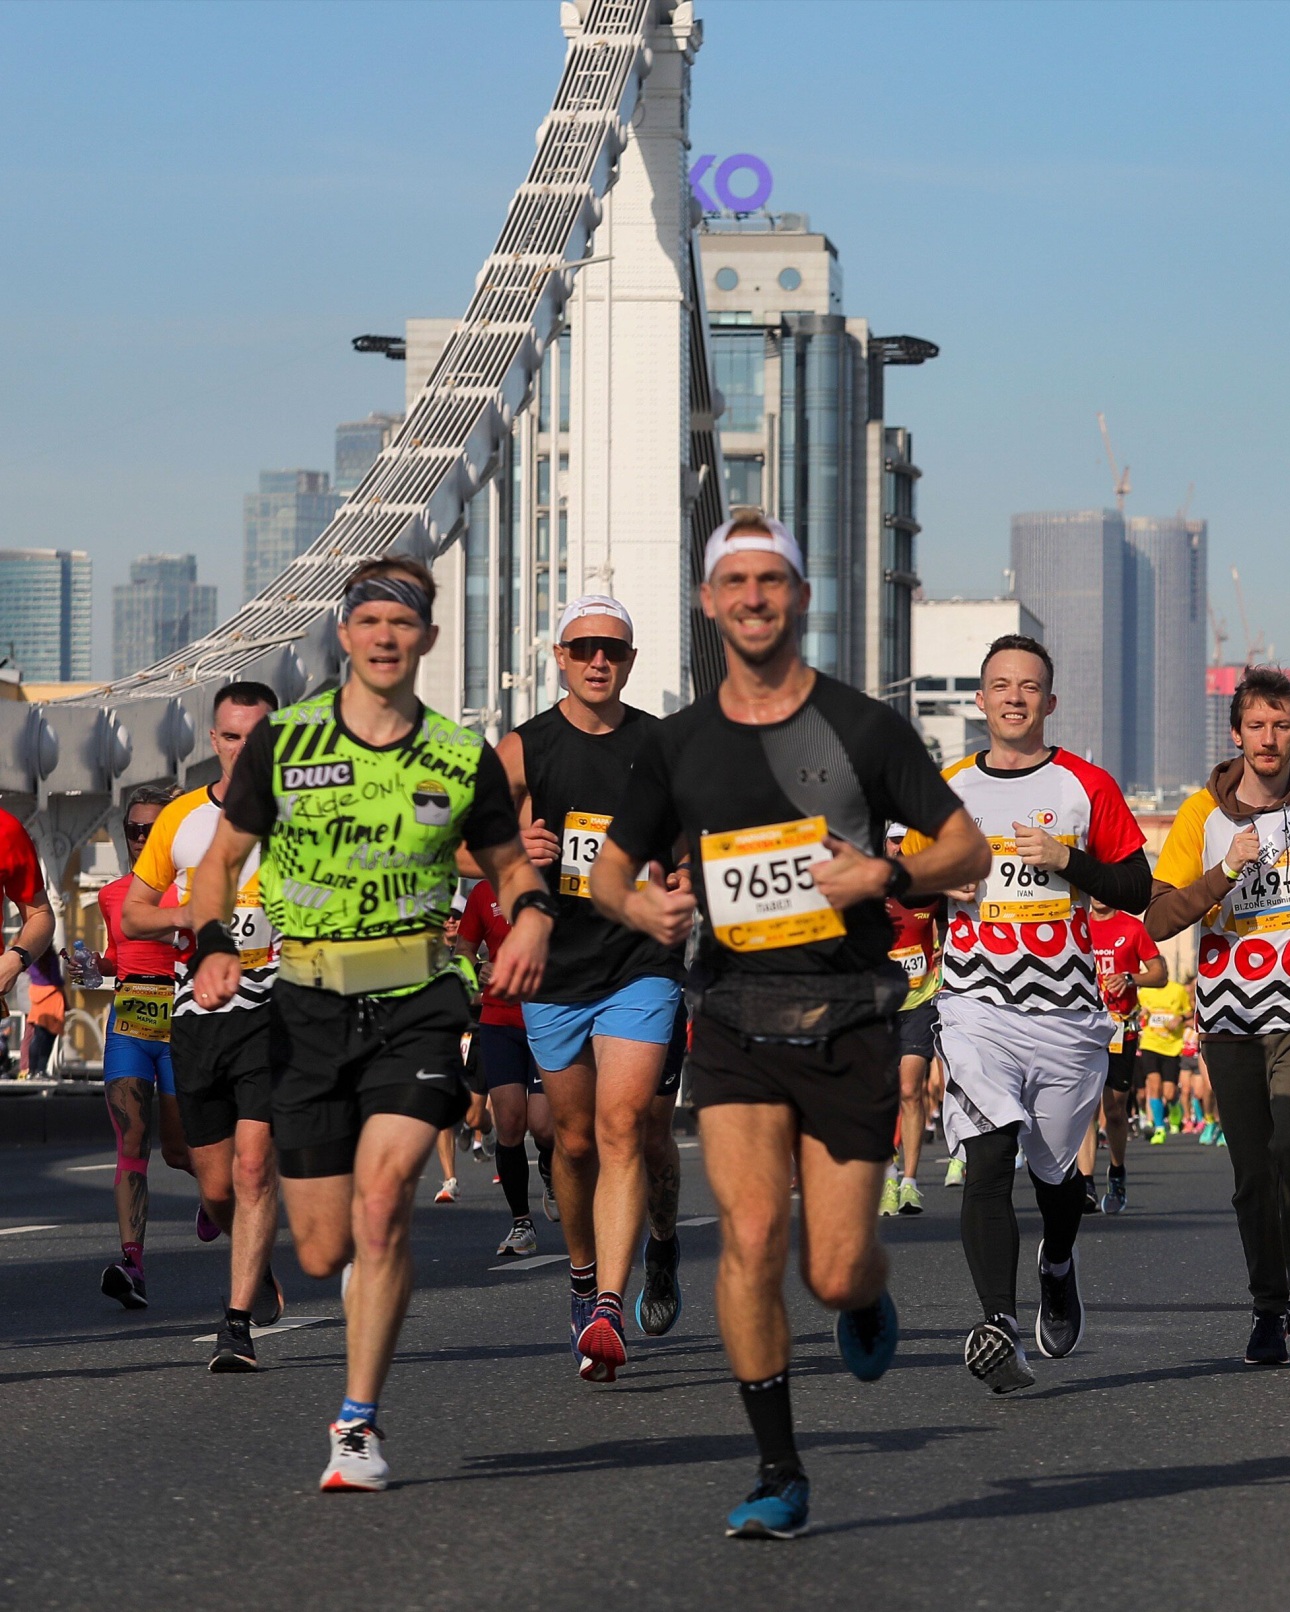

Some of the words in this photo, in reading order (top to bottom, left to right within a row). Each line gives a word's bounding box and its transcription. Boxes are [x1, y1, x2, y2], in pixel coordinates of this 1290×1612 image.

[284, 763, 350, 789] DWC
[724, 855, 815, 902] 9655
[1000, 862, 1050, 887] 968
[311, 859, 358, 890] Lane
[359, 881, 379, 915] 8
[570, 877, 580, 891] D
[1017, 889, 1034, 897] IVAN
[989, 904, 1000, 918] D
[1234, 901, 1265, 912] BI.ZONE
[123, 998, 168, 1020] 7201
[121, 1021, 130, 1032] D
[136, 1015, 157, 1026] МАРИЯ
